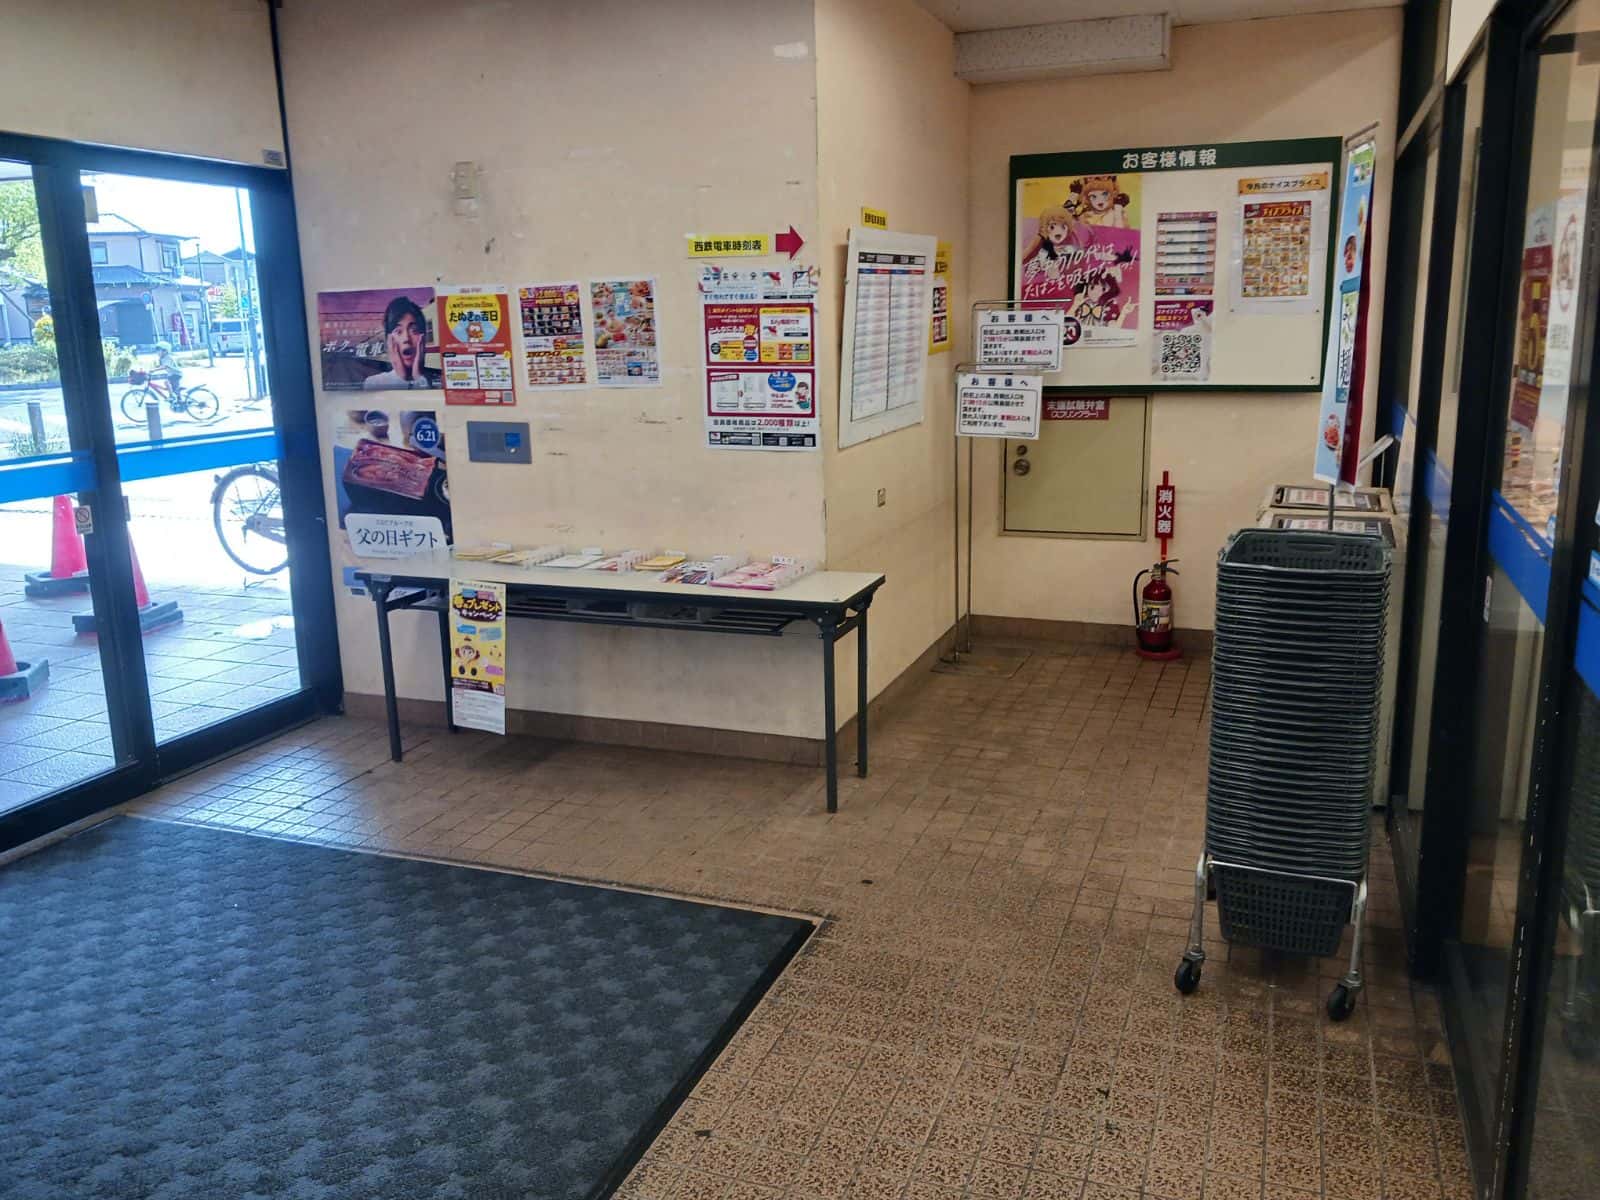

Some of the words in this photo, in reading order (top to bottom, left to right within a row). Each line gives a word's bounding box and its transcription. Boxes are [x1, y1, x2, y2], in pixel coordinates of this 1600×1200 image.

[1122, 149, 1217, 170] お客様情報
[1246, 178, 1321, 191] 今月のナイスプライス
[694, 239, 762, 252] 西鉄電車時刻表
[449, 311, 499, 322] たぬきの吉日
[971, 377, 1029, 387] お客様へ
[416, 430, 436, 442] 6.21
[1157, 489, 1173, 534] 消火器
[356, 528, 438, 548] 父の日ギフト
